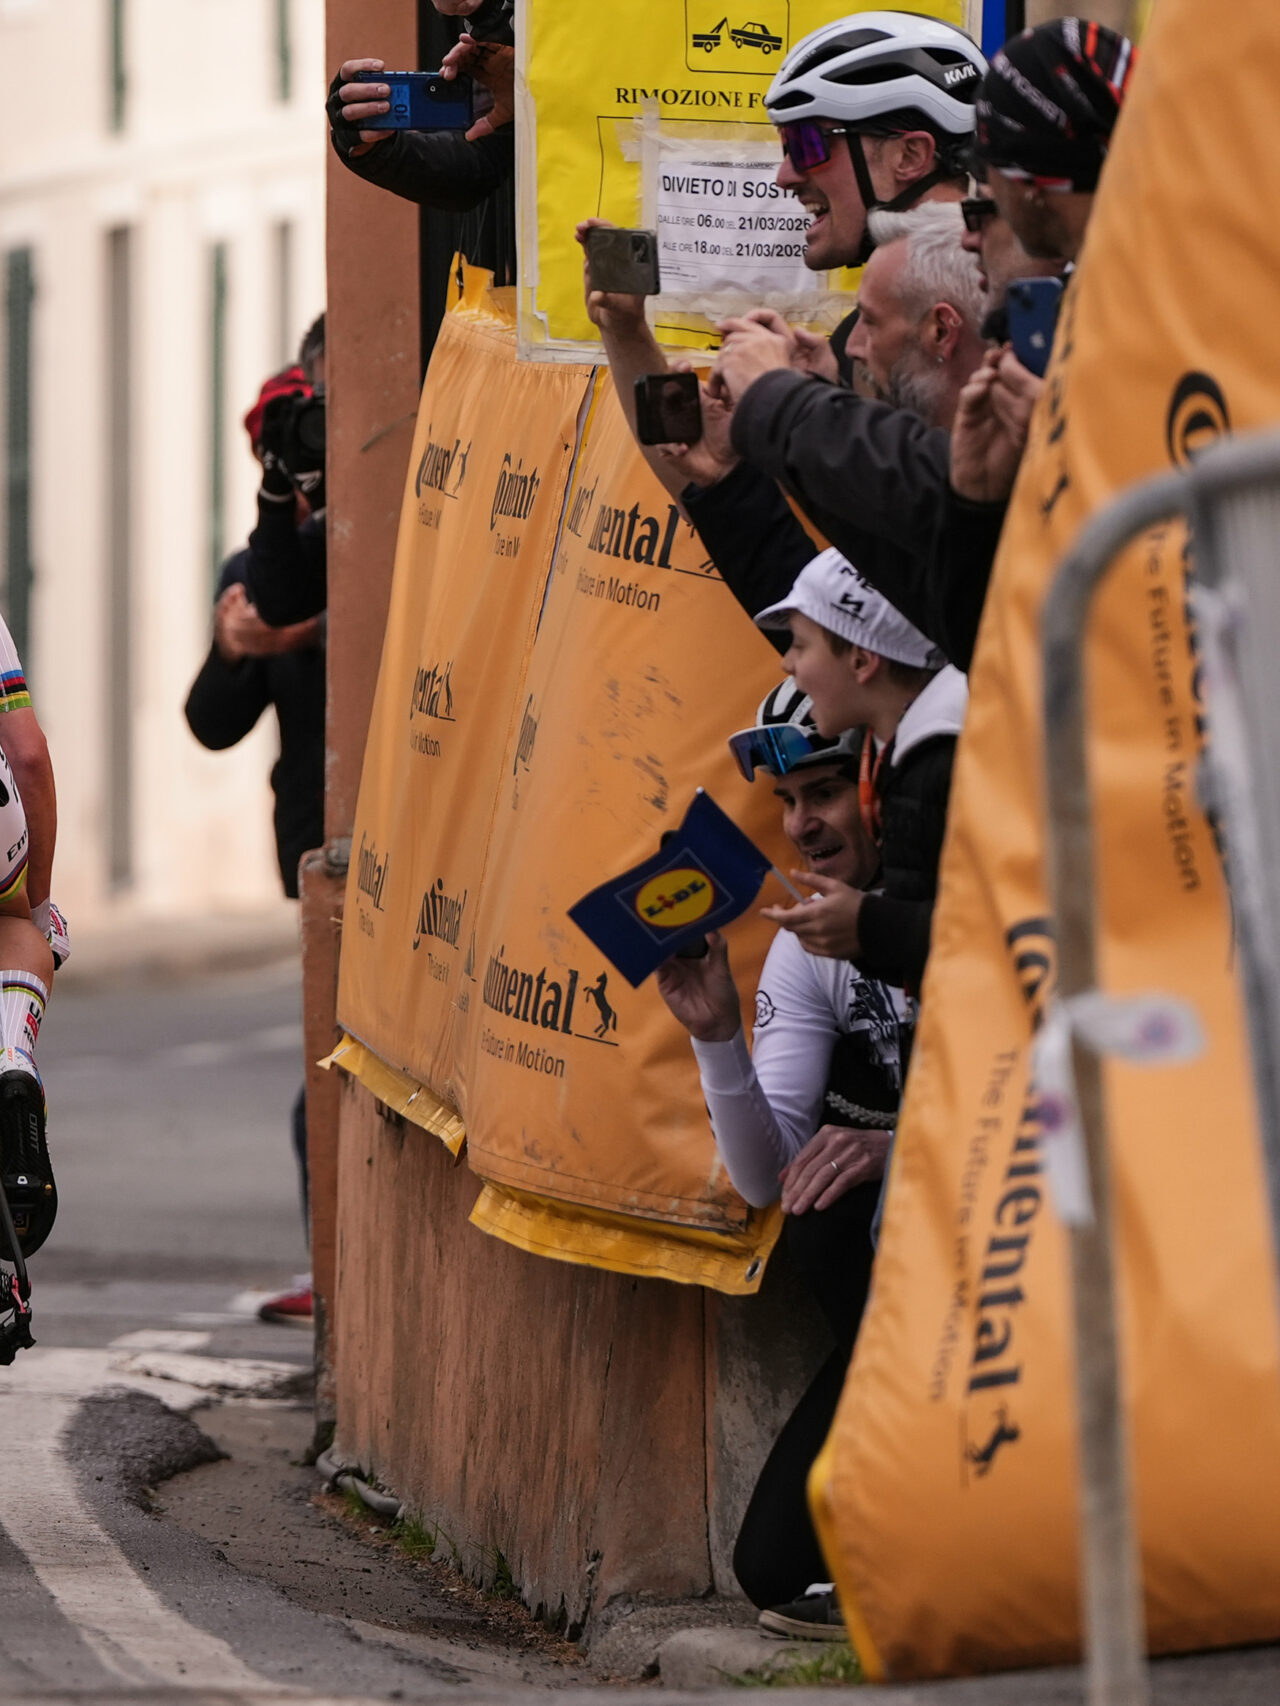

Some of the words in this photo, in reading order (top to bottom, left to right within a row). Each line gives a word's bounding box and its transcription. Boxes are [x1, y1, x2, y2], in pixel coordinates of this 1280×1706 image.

[943, 64, 977, 84] KASK
[616, 87, 743, 108] RIMOZIONE
[662, 175, 724, 197] DIVIETO
[697, 214, 724, 229] 06.00
[738, 216, 811, 231] 21/03/2026
[694, 240, 720, 255] 18.00
[736, 243, 808, 258] 21/03/2026
[606, 576, 661, 613] Motion
[1161, 762, 1204, 893] Motion
[515, 1040, 566, 1079] Motion
